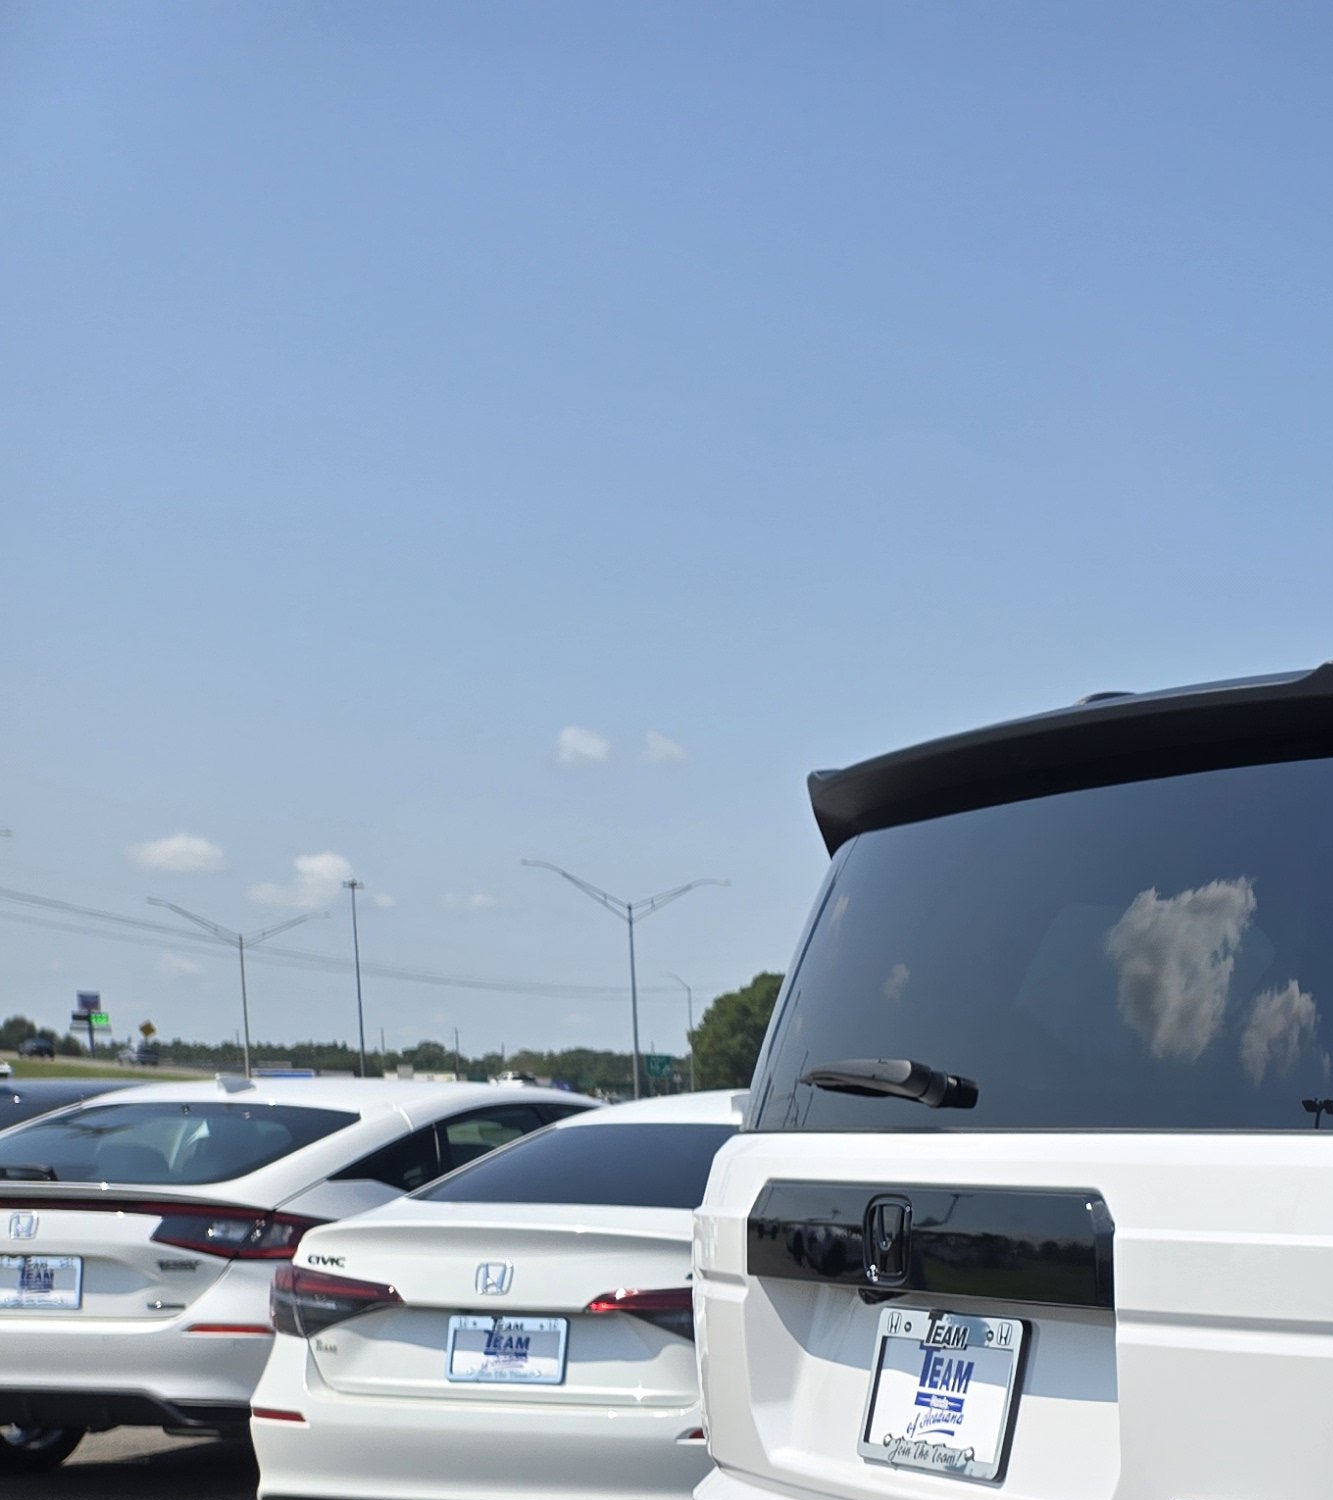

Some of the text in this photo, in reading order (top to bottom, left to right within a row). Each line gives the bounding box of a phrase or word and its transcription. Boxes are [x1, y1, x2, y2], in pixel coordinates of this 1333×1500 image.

[308, 1255, 346, 1268] CIVIC
[484, 1330, 531, 1350] TEAM
[925, 1309, 969, 1349] TEAM
[919, 1343, 975, 1394] TEAM
